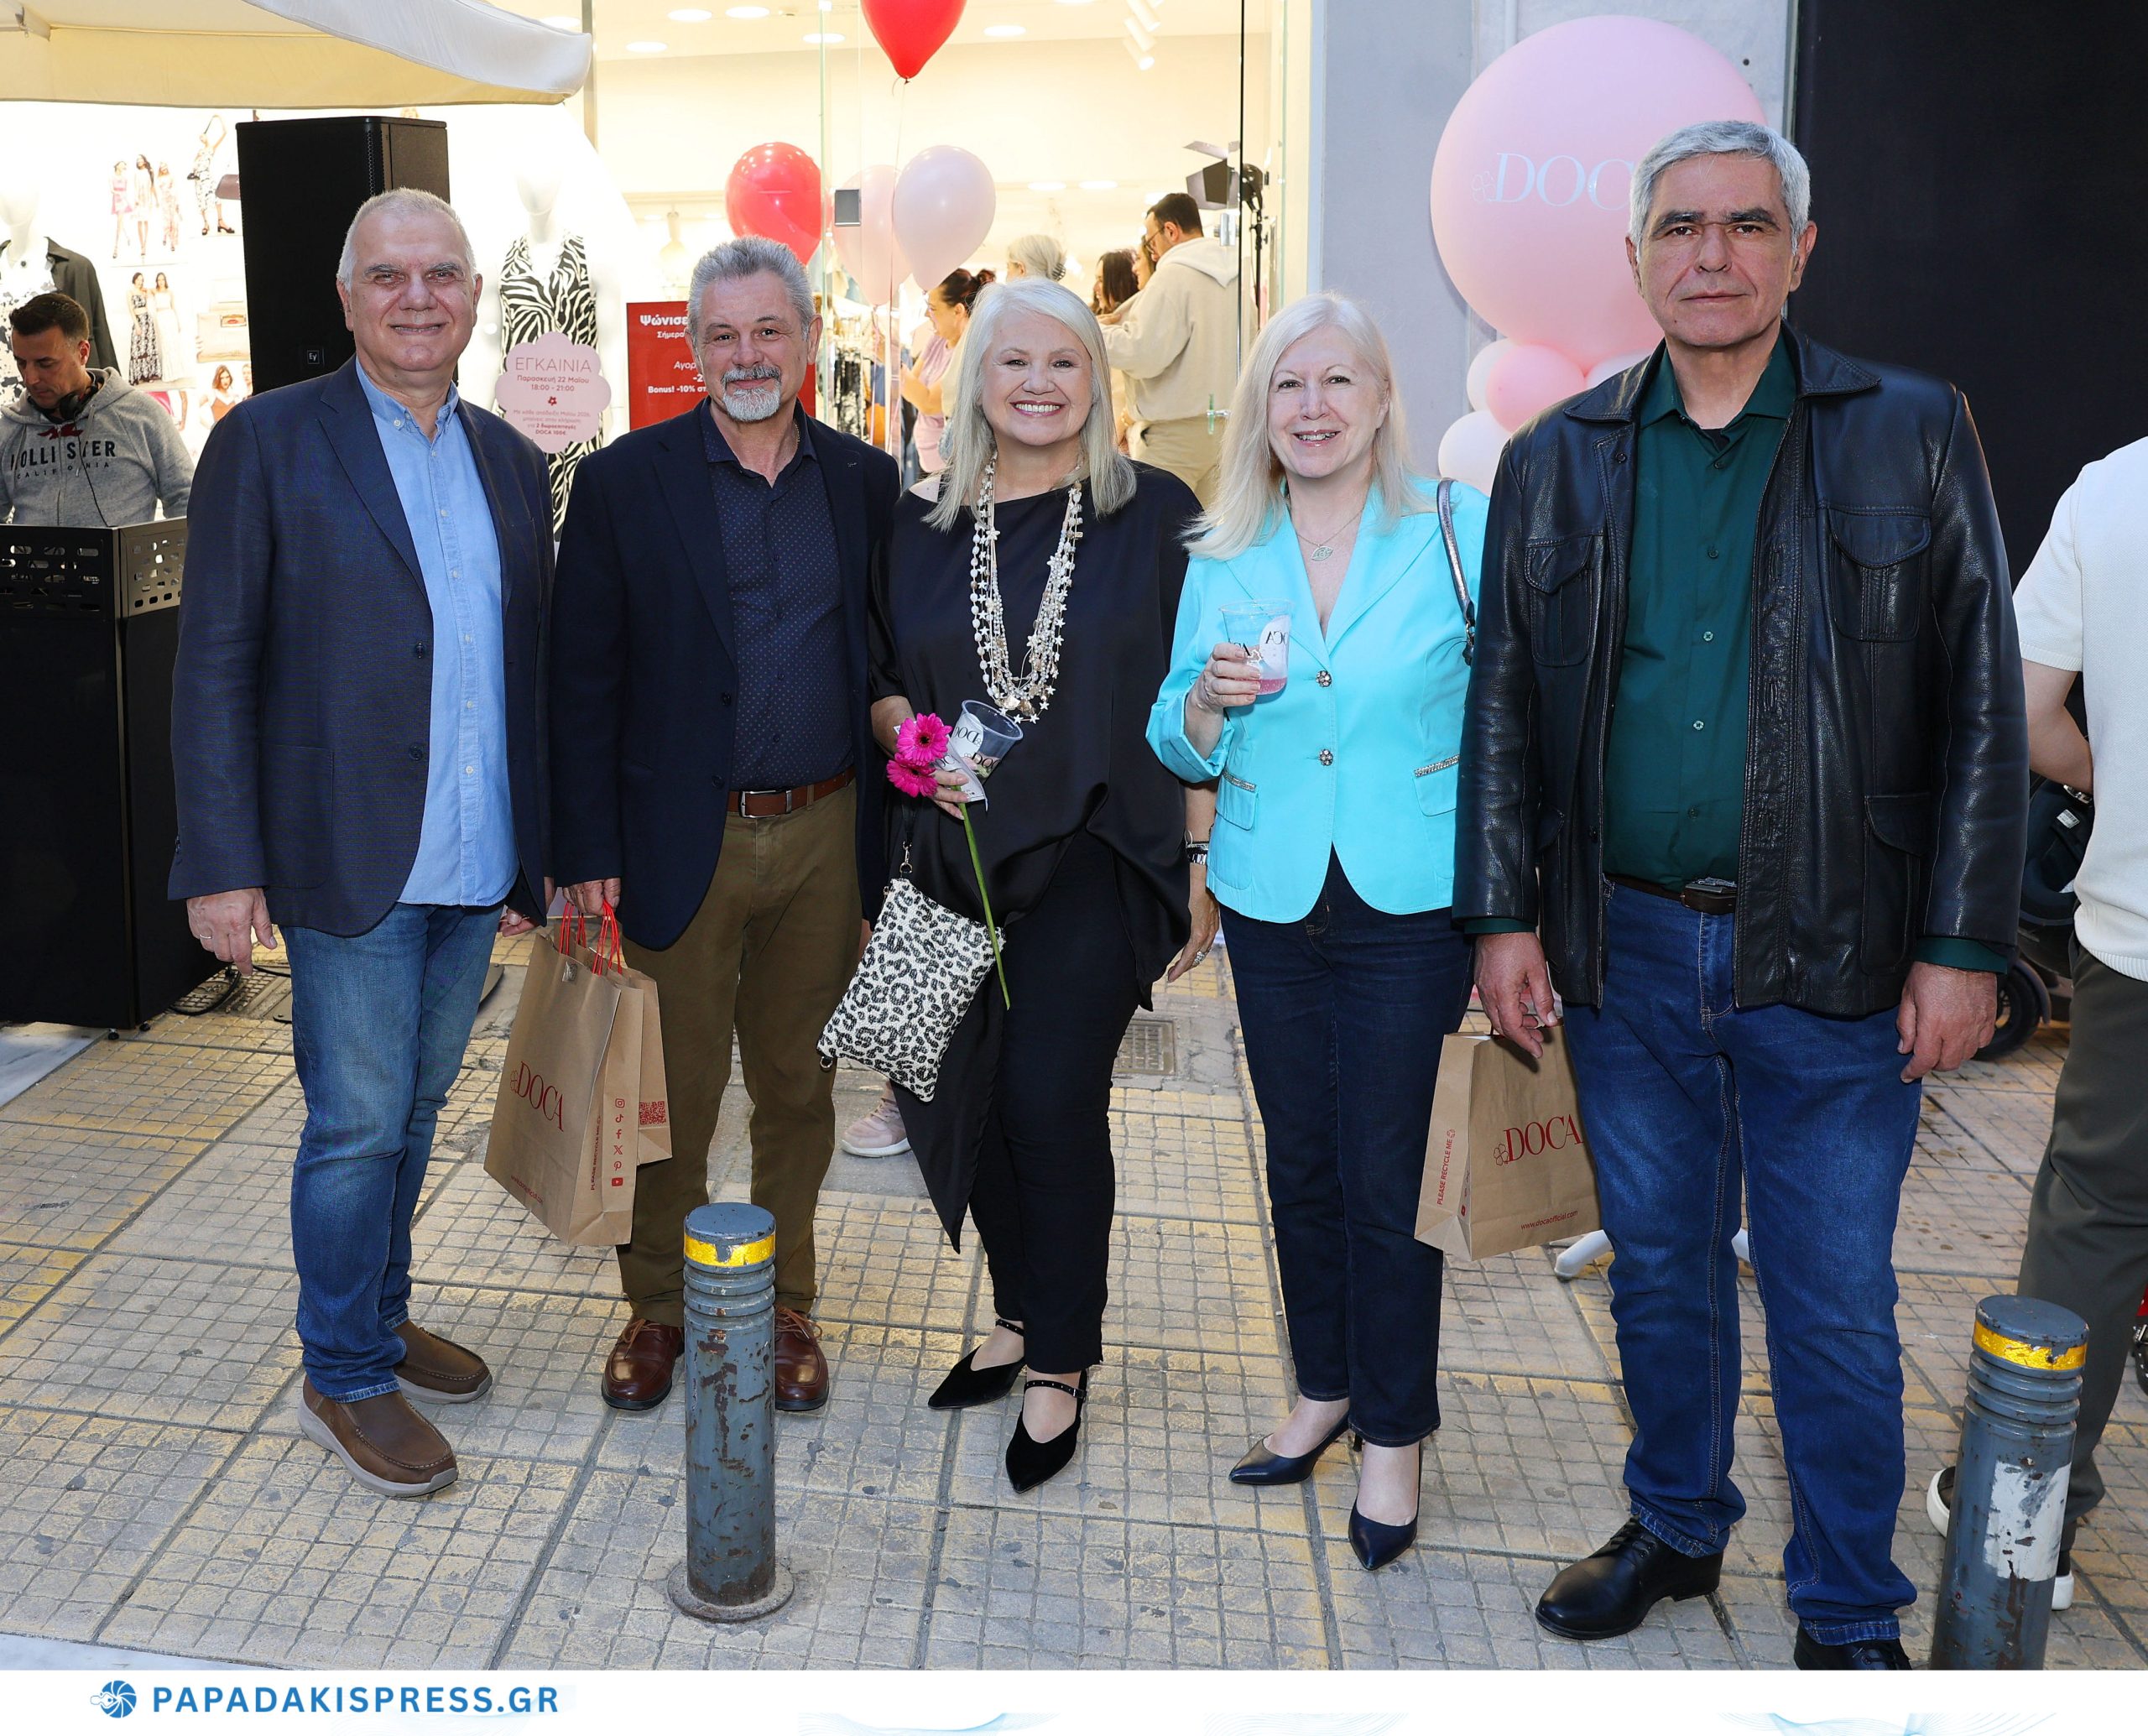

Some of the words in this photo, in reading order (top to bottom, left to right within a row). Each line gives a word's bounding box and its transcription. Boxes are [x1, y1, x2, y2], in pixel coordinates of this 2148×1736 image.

[1488, 152, 1635, 211] DOC
[515, 357, 592, 373] ΕΓΚΑΙΝΙΑ
[674, 361, 697, 371] Αγορ
[517, 375, 556, 383] Παρασκευή
[693, 373, 704, 383] -2
[648, 385, 675, 394] Bonus!
[17, 461, 109, 479] CALIFONIA
[971, 752, 1002, 770] DOC
[515, 1061, 565, 1133] DOCA
[1446, 1139, 1453, 1150] ME
[1503, 1113, 1584, 1163] DOCA
[1441, 1150, 1451, 1181] RECYCLE
[1437, 1181, 1446, 1206] PLEASE
